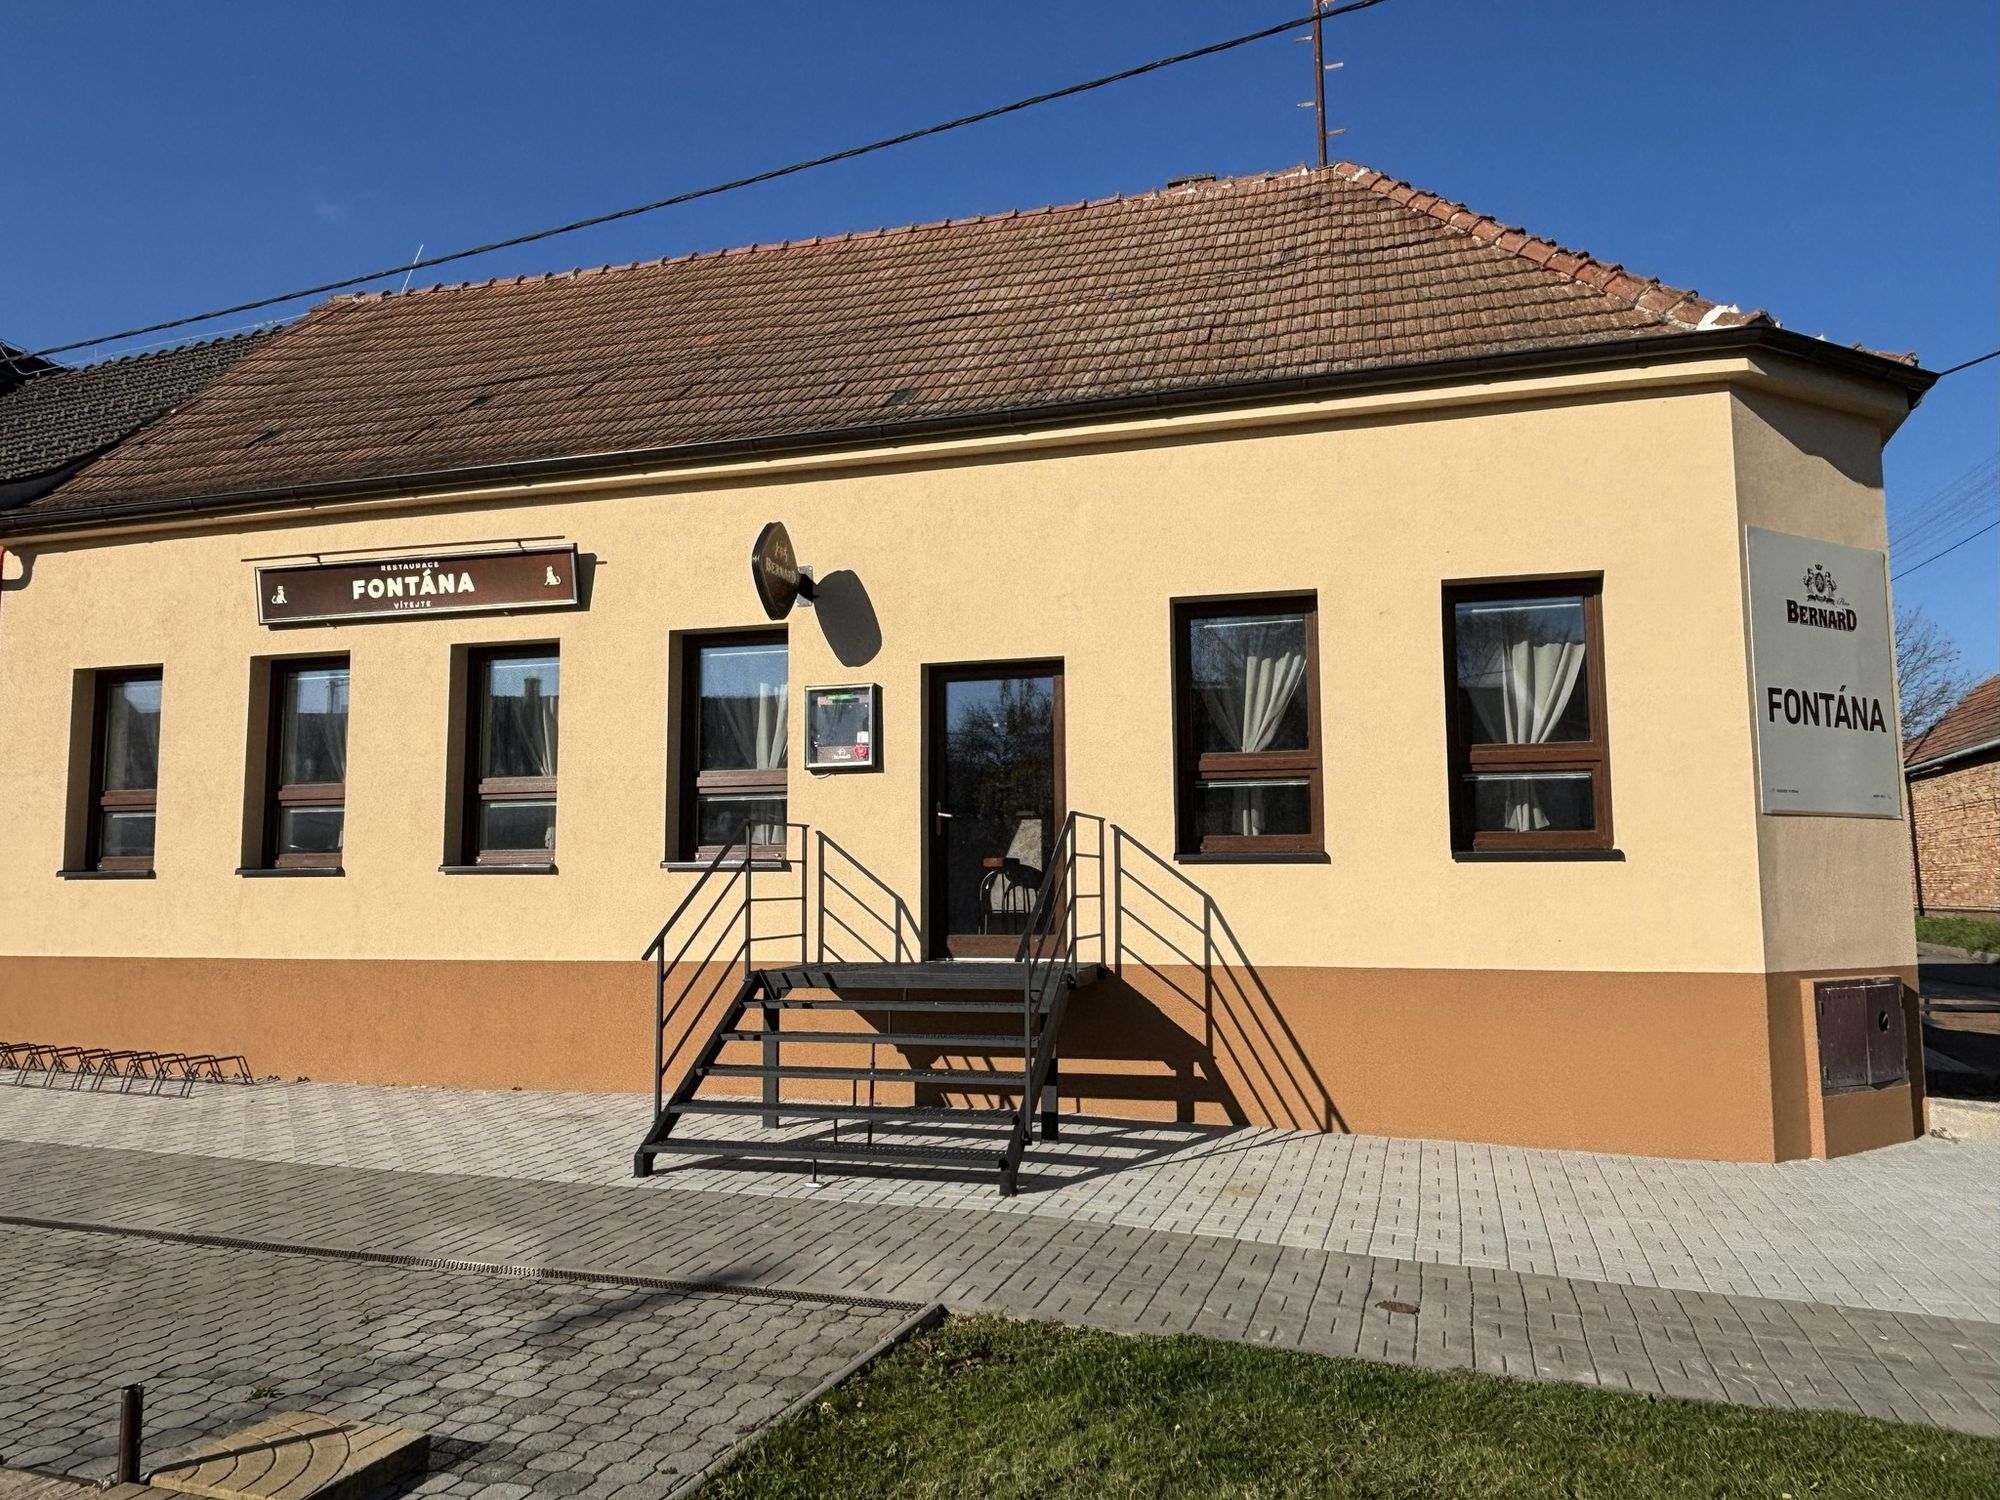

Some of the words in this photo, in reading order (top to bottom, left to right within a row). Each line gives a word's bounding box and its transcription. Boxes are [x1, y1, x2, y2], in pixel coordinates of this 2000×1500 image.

[380, 561, 440, 571] RESTAURACE
[352, 568, 475, 600] FONTÁNA
[393, 601, 432, 609] VÍTEJTE
[1786, 599, 1858, 632] BERNARD
[1767, 684, 1887, 733] FONTÁNA
